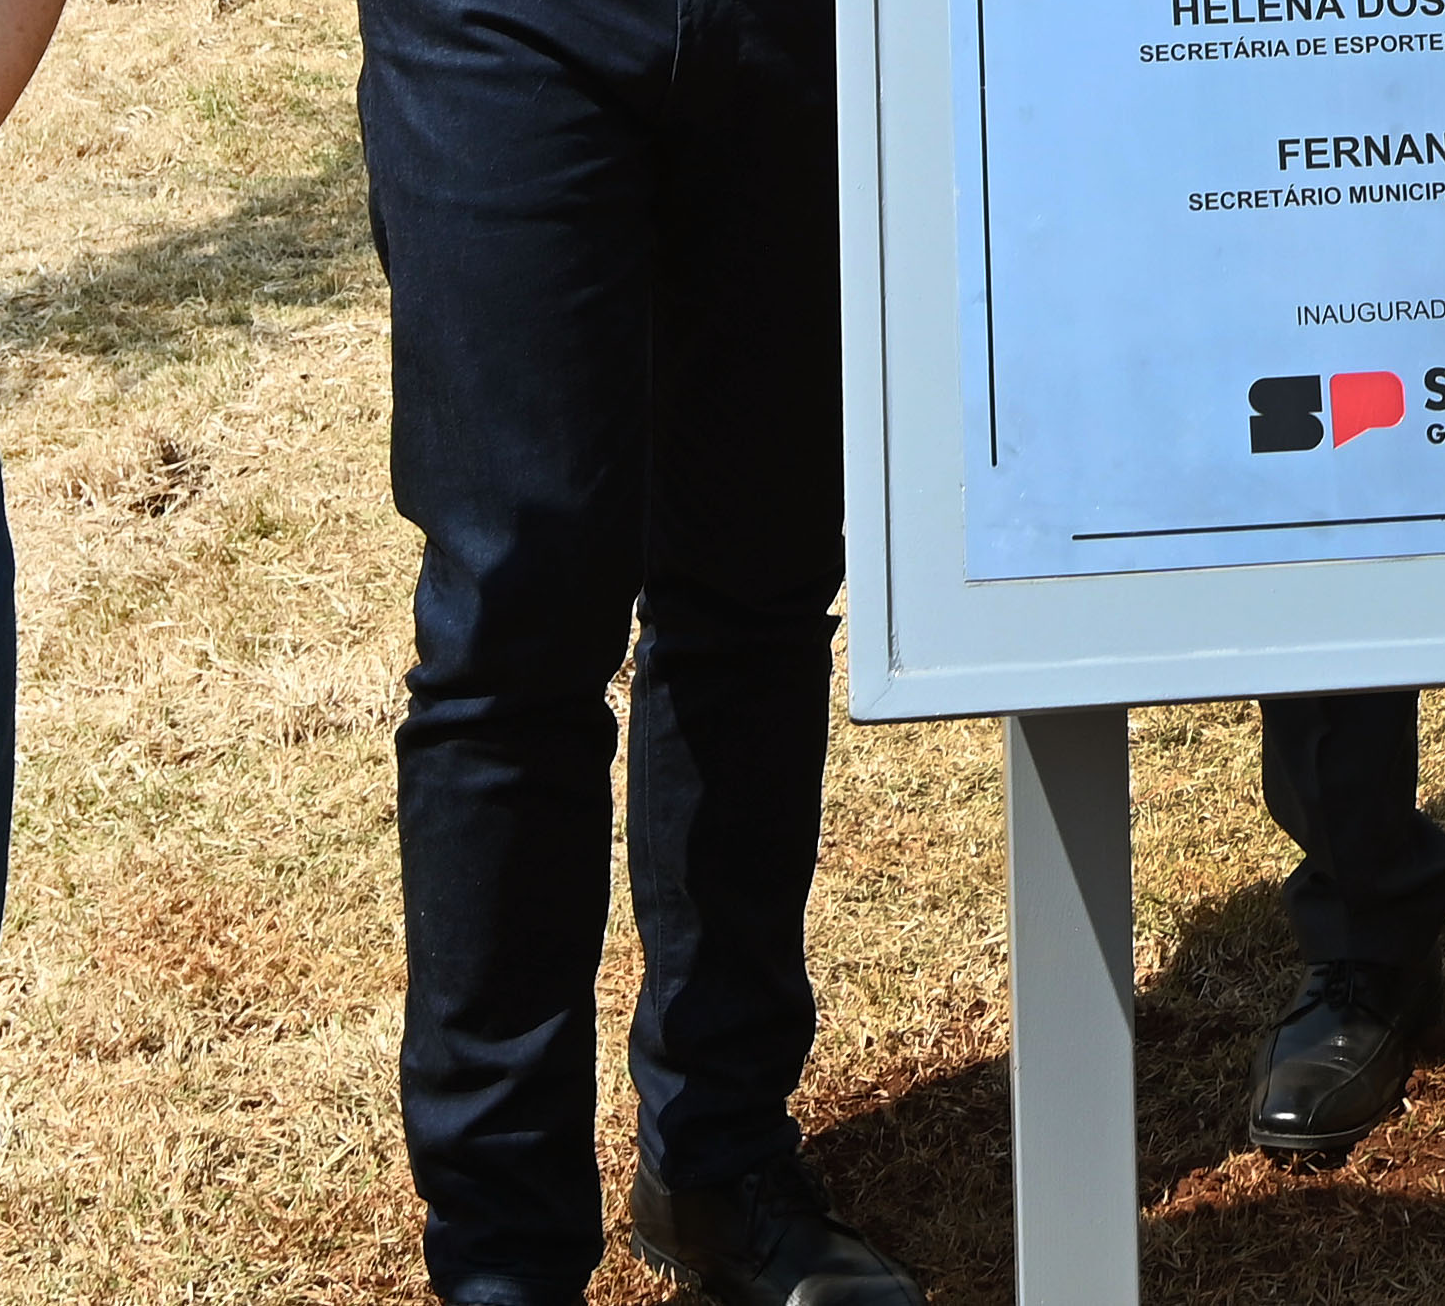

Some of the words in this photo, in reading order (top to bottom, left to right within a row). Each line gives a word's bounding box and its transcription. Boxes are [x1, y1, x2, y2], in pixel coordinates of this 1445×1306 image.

[1140, 36, 1290, 63] SECRETÁRIA
[1296, 37, 1327, 56] DE
[1189, 183, 1342, 211] SECRETÁRIO
